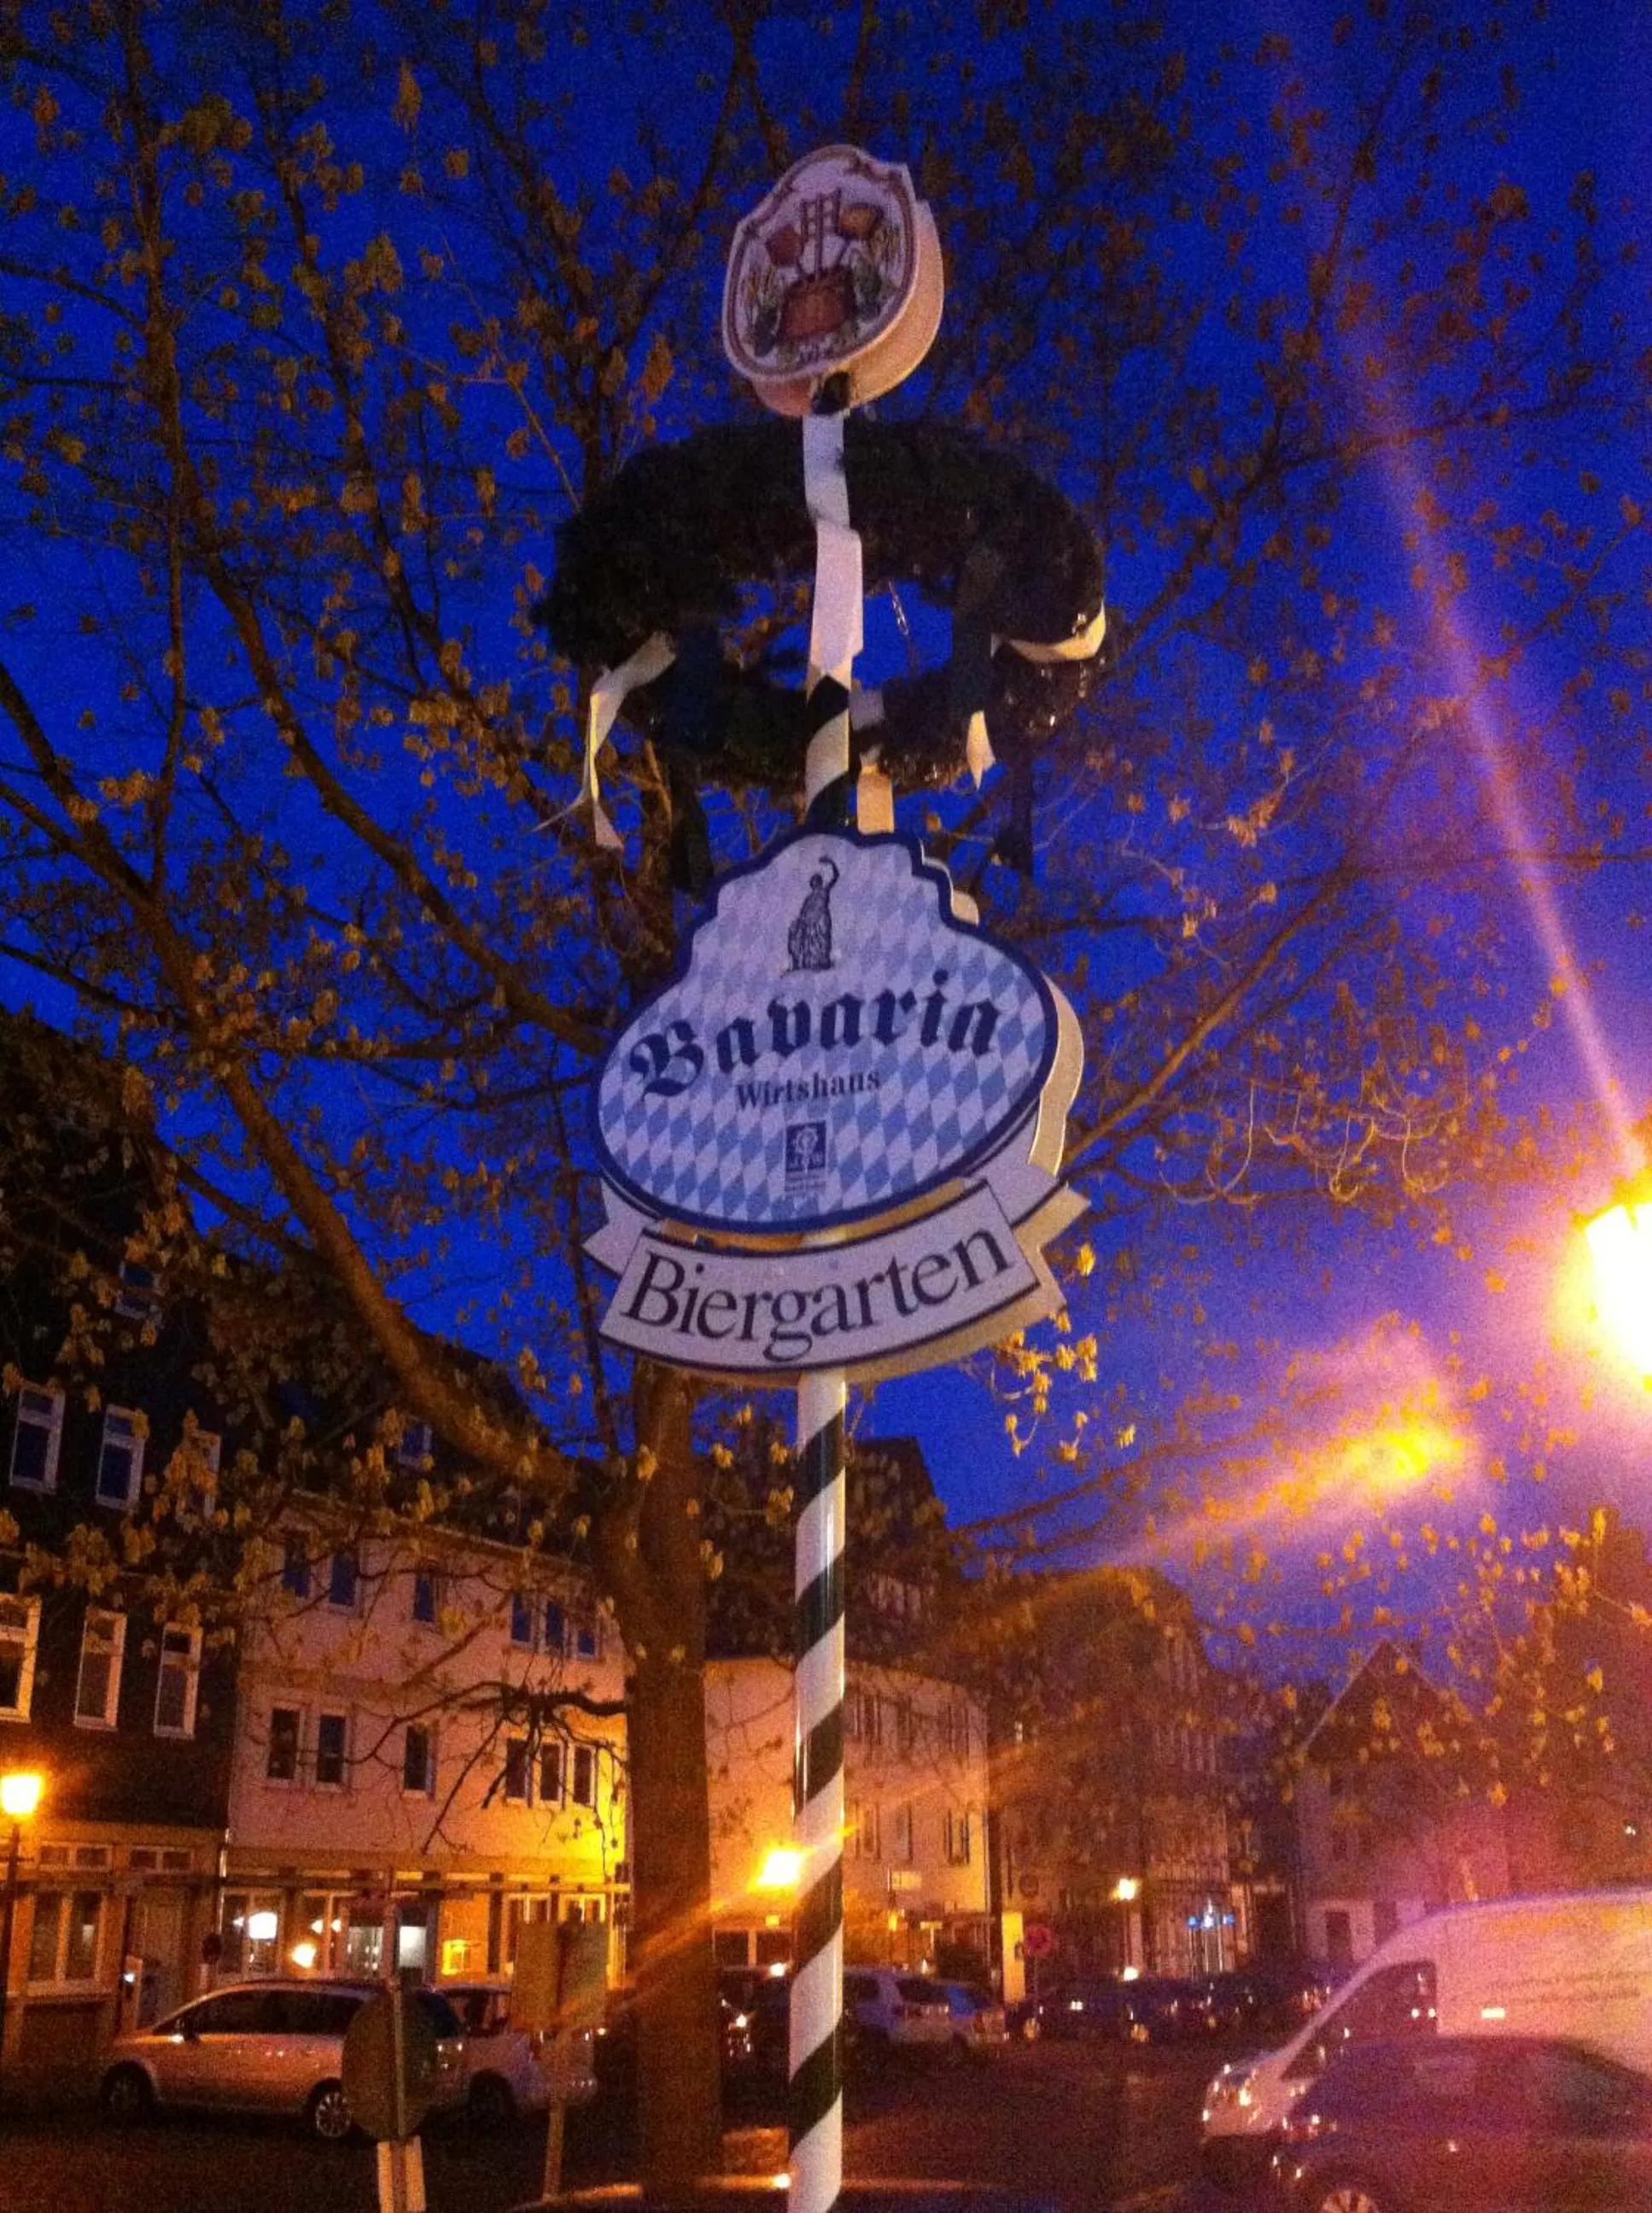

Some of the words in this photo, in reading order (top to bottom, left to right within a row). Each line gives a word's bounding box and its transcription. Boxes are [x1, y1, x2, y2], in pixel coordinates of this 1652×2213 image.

[629, 970, 1001, 1097] Bavaria
[736, 1071, 883, 1110] Wirtshaus
[620, 1227, 1013, 1361] Biergarten
